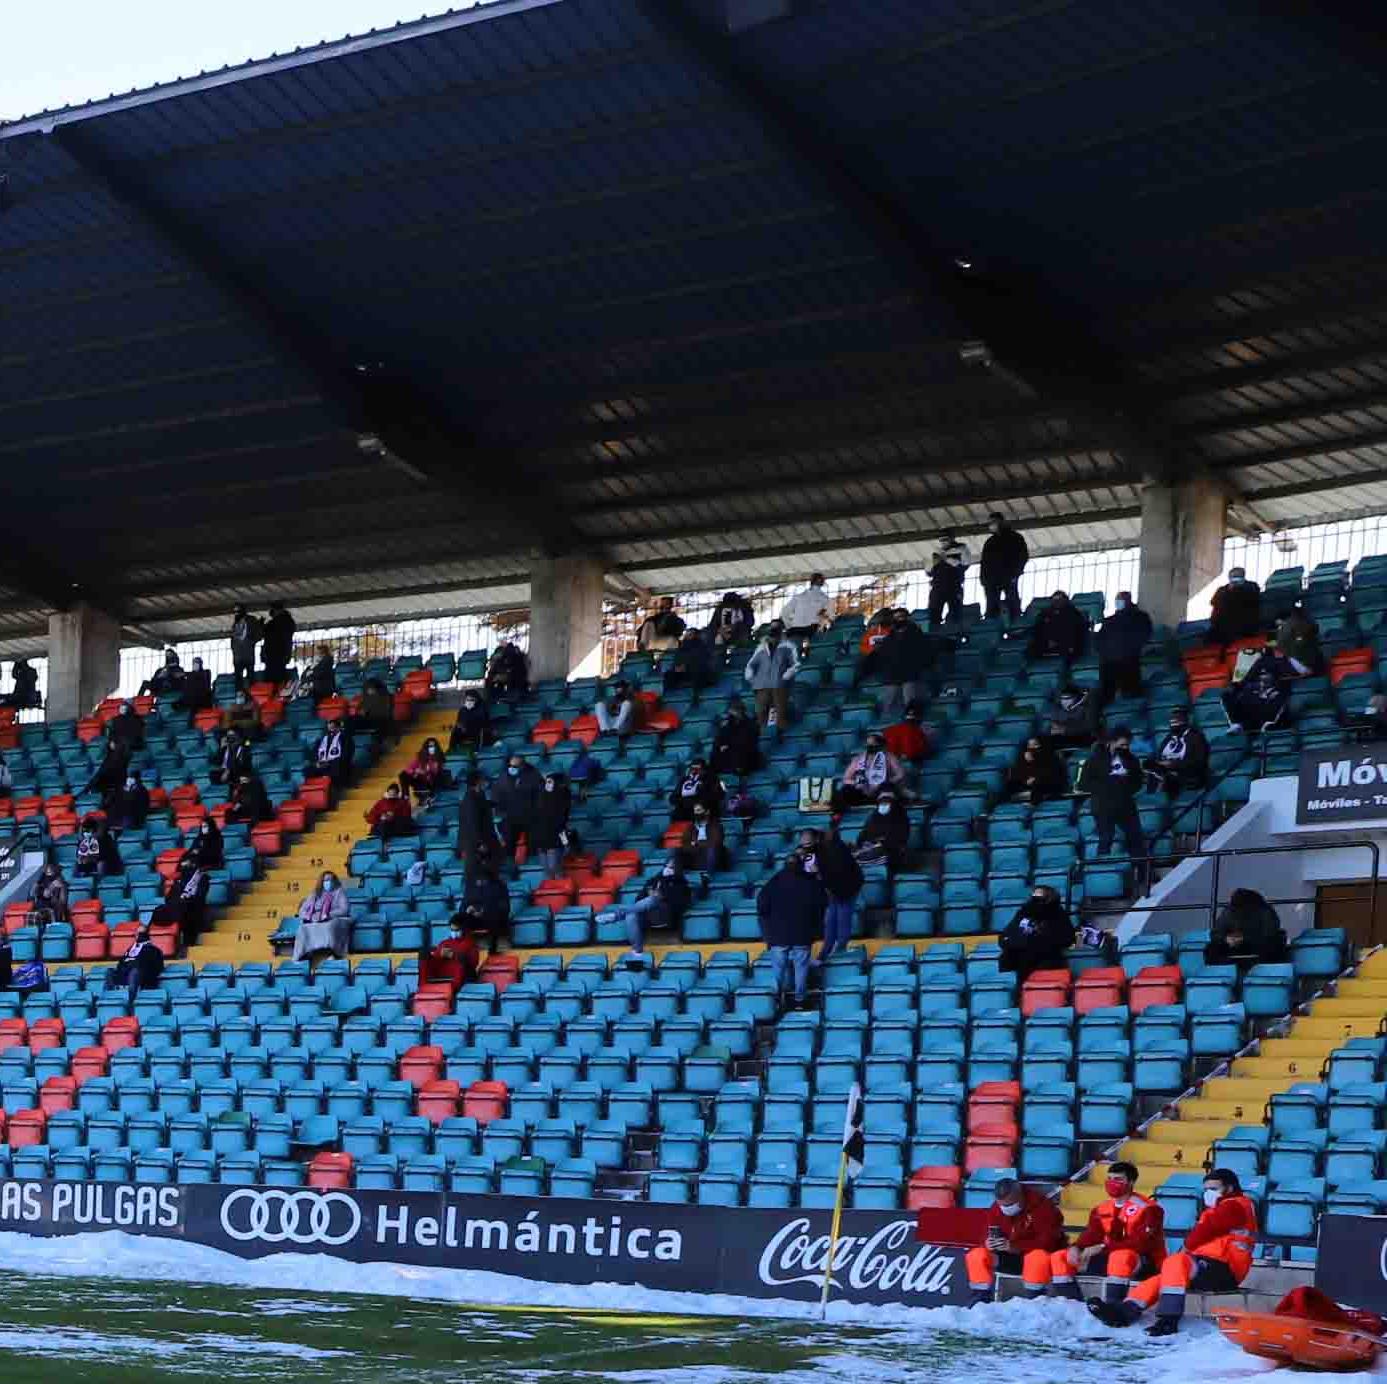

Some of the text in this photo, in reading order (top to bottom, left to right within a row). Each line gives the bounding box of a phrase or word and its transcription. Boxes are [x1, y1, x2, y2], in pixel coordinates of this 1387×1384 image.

[1307, 799, 1361, 811] Móviles
[51, 1183, 180, 1227] PULGAS
[376, 1203, 683, 1261] Helmántica
[758, 1217, 956, 1295] Coca-Cola
